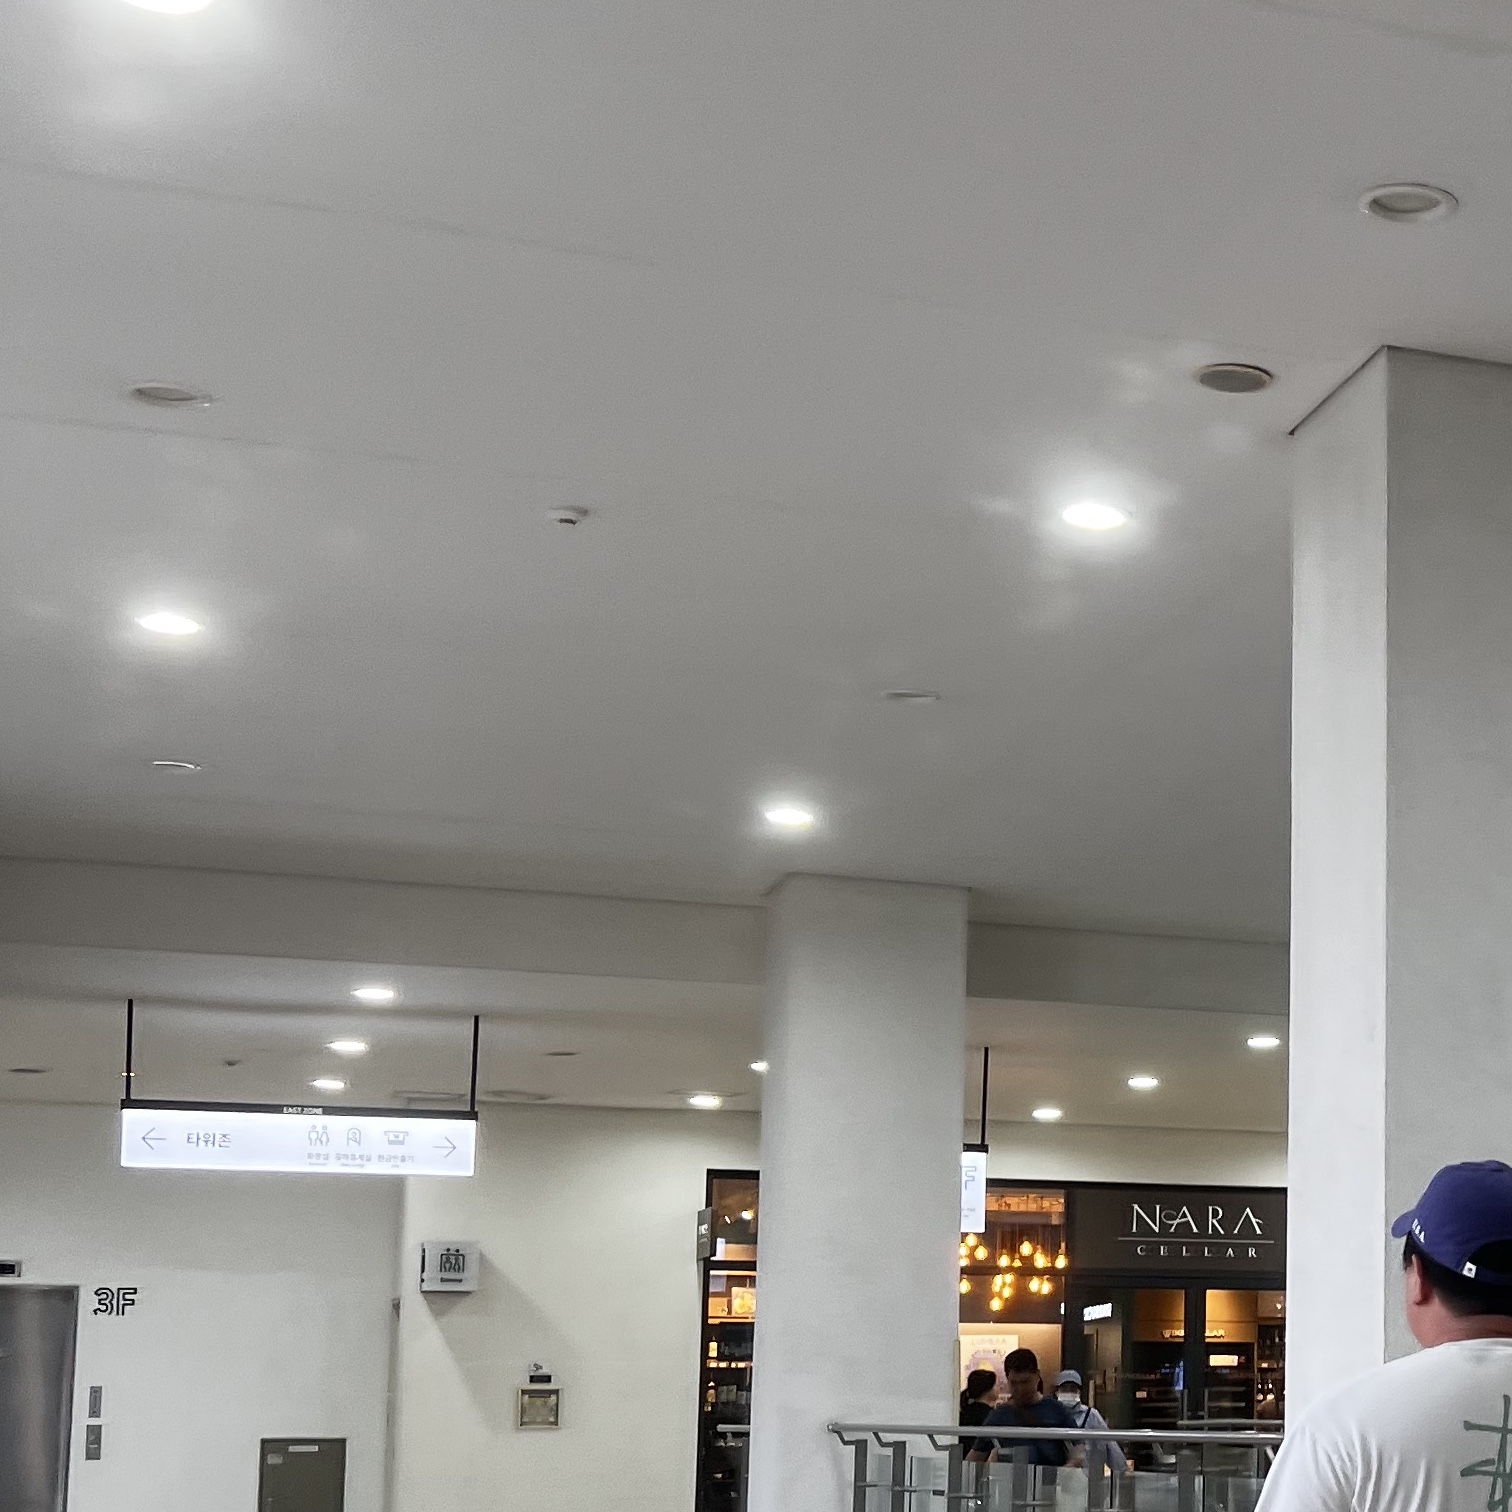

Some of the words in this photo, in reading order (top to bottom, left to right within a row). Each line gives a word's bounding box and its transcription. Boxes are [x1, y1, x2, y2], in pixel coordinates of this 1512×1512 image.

[186, 1131, 232, 1149] 타워존
[1131, 1203, 1264, 1235] NARA
[1136, 1244, 1258, 1258] CELLAR
[93, 1287, 138, 1316] 3F
